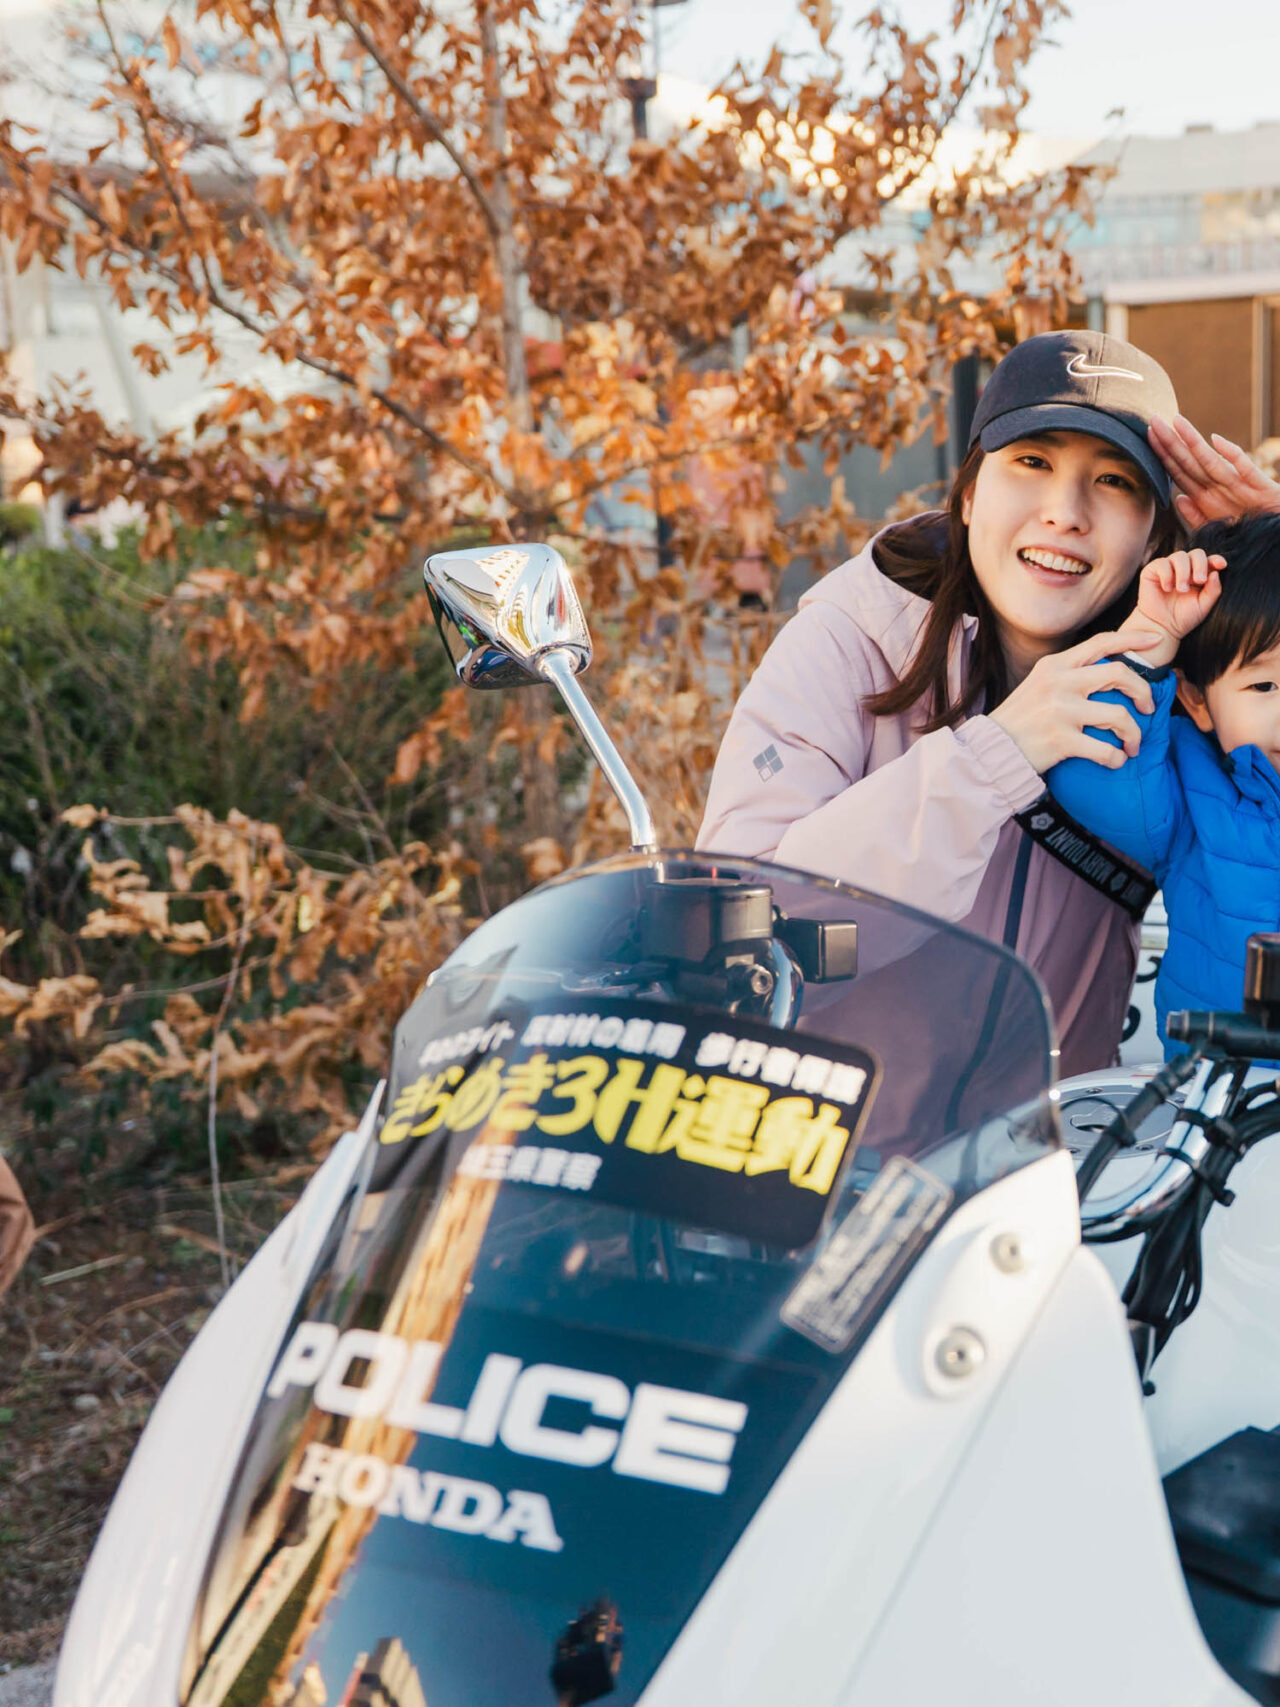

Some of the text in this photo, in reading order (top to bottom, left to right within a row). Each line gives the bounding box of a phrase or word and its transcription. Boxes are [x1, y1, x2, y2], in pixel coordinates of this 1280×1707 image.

[1045, 826, 1116, 885] MARY QUANT
[379, 1053, 850, 1195] きらめき3H運動
[267, 1321, 749, 1496] POLICE
[295, 1442, 565, 1552] HONDA
